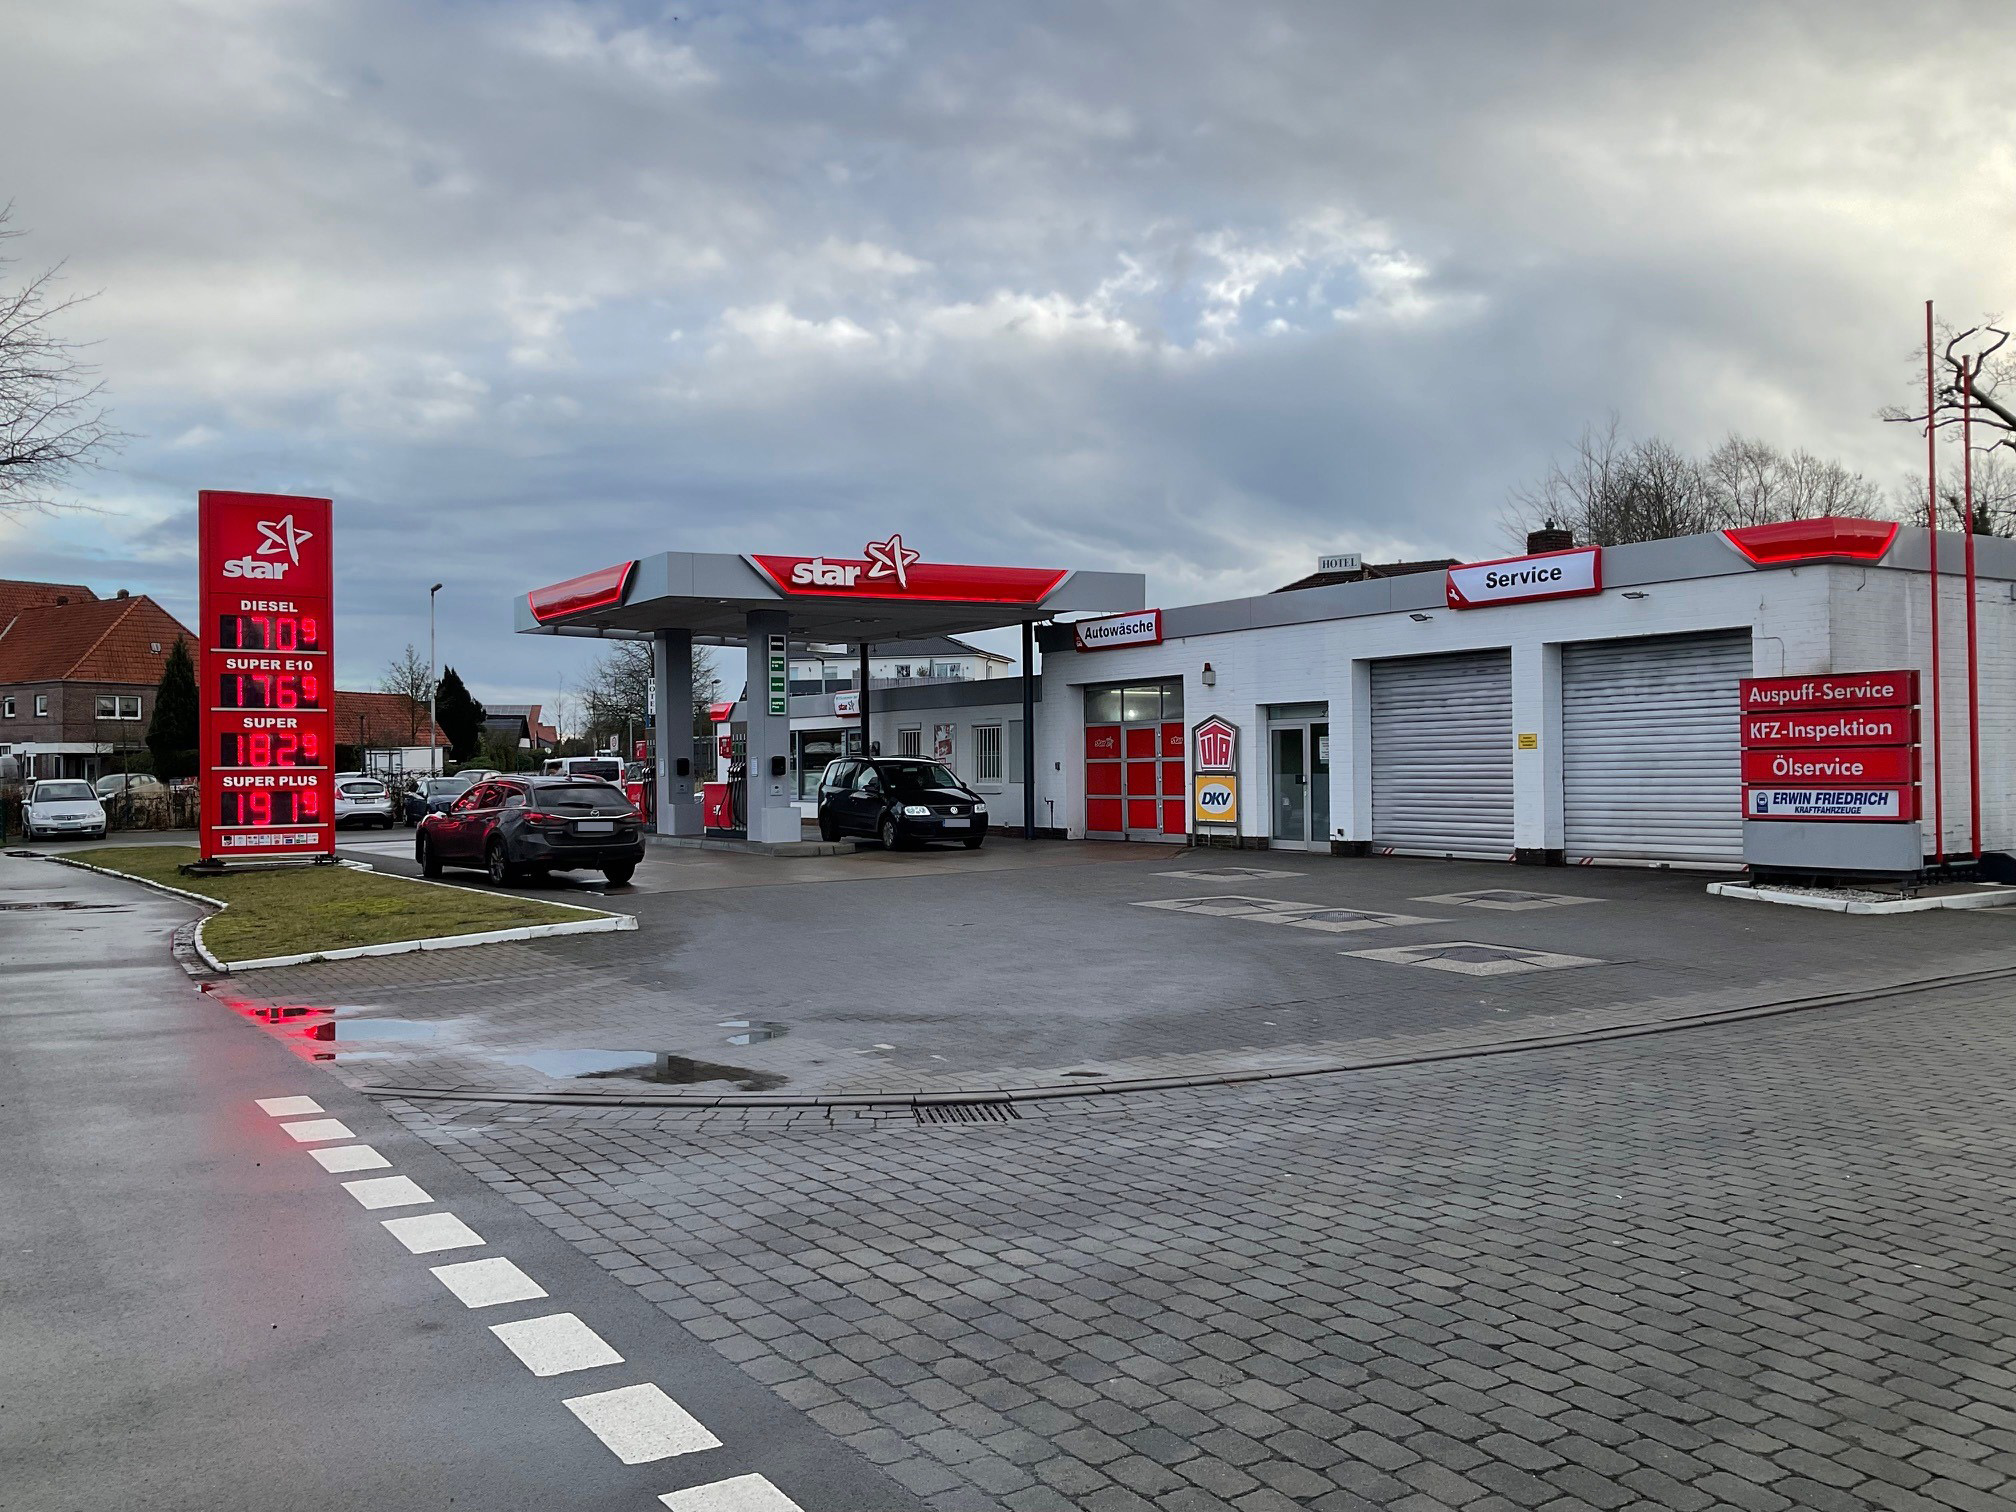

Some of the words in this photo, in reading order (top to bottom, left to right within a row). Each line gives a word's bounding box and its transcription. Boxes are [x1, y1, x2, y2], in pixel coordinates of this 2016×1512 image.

[222, 555, 289, 580] star
[792, 557, 861, 587] star
[1322, 558, 1358, 569] HOTEL
[1485, 567, 1562, 589] Service
[240, 600, 299, 613] DIESEL
[1085, 620, 1154, 640] Autowäsche
[226, 658, 281, 670] SUPER
[285, 660, 314, 671] E10
[1749, 680, 1895, 706] Auspuff-Service
[243, 717, 298, 729] SUPER
[1750, 718, 1892, 741] KFZ-Inspektion
[237, 733, 319, 768] 1829
[1199, 724, 1232, 766] UTA
[1772, 754, 1864, 776] Ölservice
[222, 776, 275, 787] SUPER
[279, 775, 318, 787] PLUS
[1201, 792, 1231, 806] DKV
[1772, 792, 1812, 805] ERWIN
[1814, 792, 1889, 805] FRIEDRICH
[1794, 806, 1862, 814] KRAFTFAHRZEUGE
